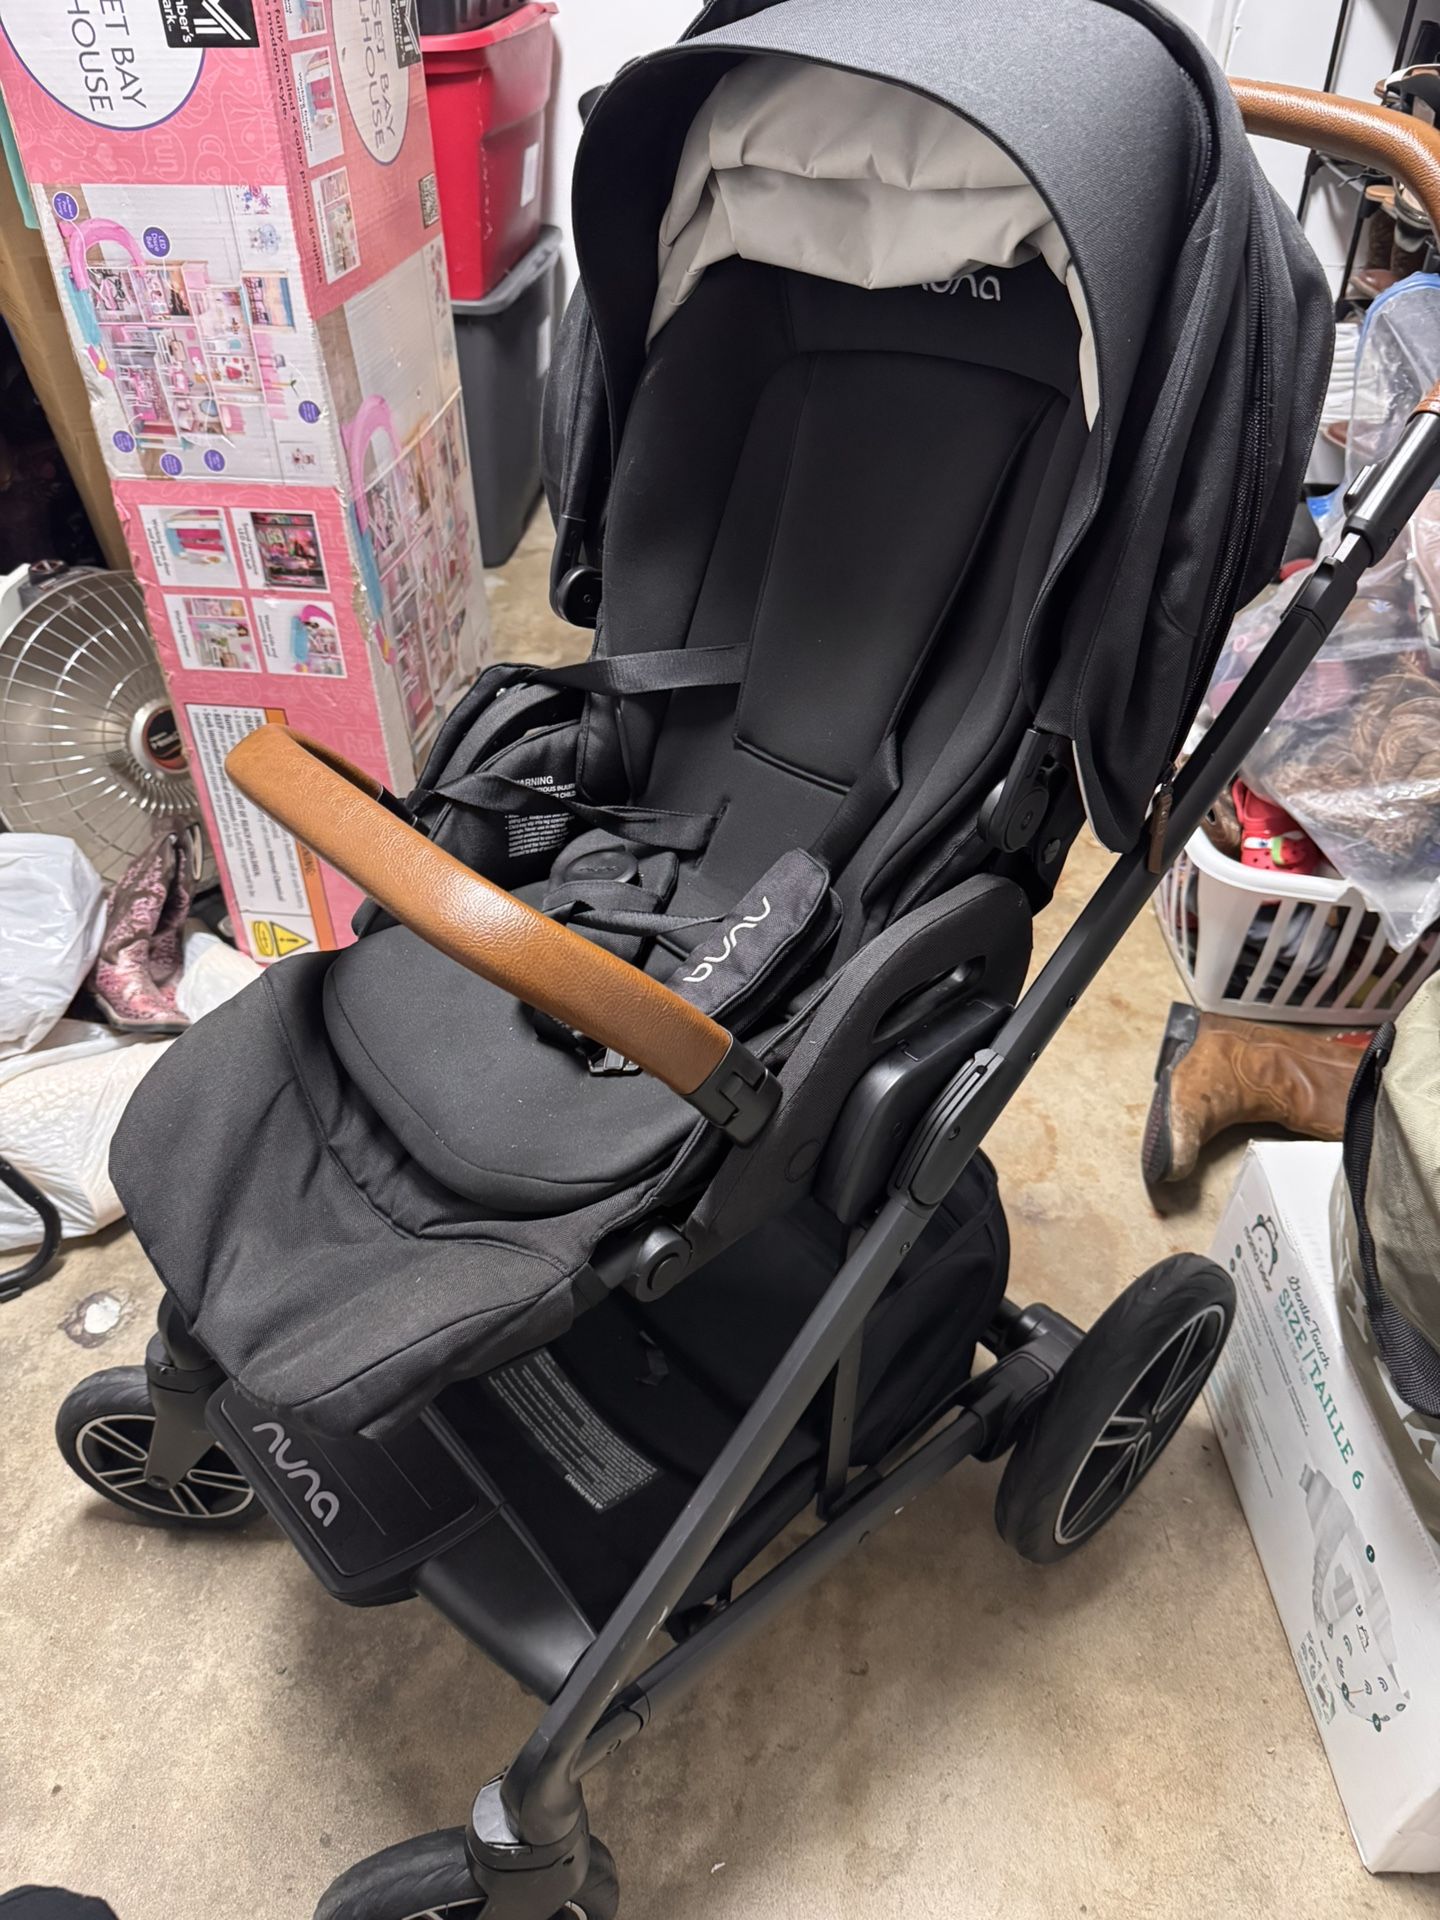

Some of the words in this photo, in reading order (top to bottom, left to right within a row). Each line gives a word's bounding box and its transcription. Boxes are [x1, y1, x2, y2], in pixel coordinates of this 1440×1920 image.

[67, 0, 114, 112] HOUSE
[100, 0, 130, 36] ET
[265, 11, 282, 73] modern
[276, 78, 290, 120] style.
[371, 0, 387, 61] SET
[379, 74, 395, 136] BAY
[111, 48, 147, 109] BAY
[278, 48, 295, 110] detailed
[292, 128, 304, 166] color
[298, 170, 314, 222] printed
[307, 227, 324, 283] graphics
[921, 274, 1001, 302] una
[1287, 1275, 1312, 1326] Gentle
[1309, 1319, 1330, 1370] Touch
[1278, 1288, 1308, 1350] SIZE
[1308, 1361, 1354, 1464] TAILLE
[1351, 1470, 1365, 1490] 6
[252, 1422, 340, 1527] nuna
